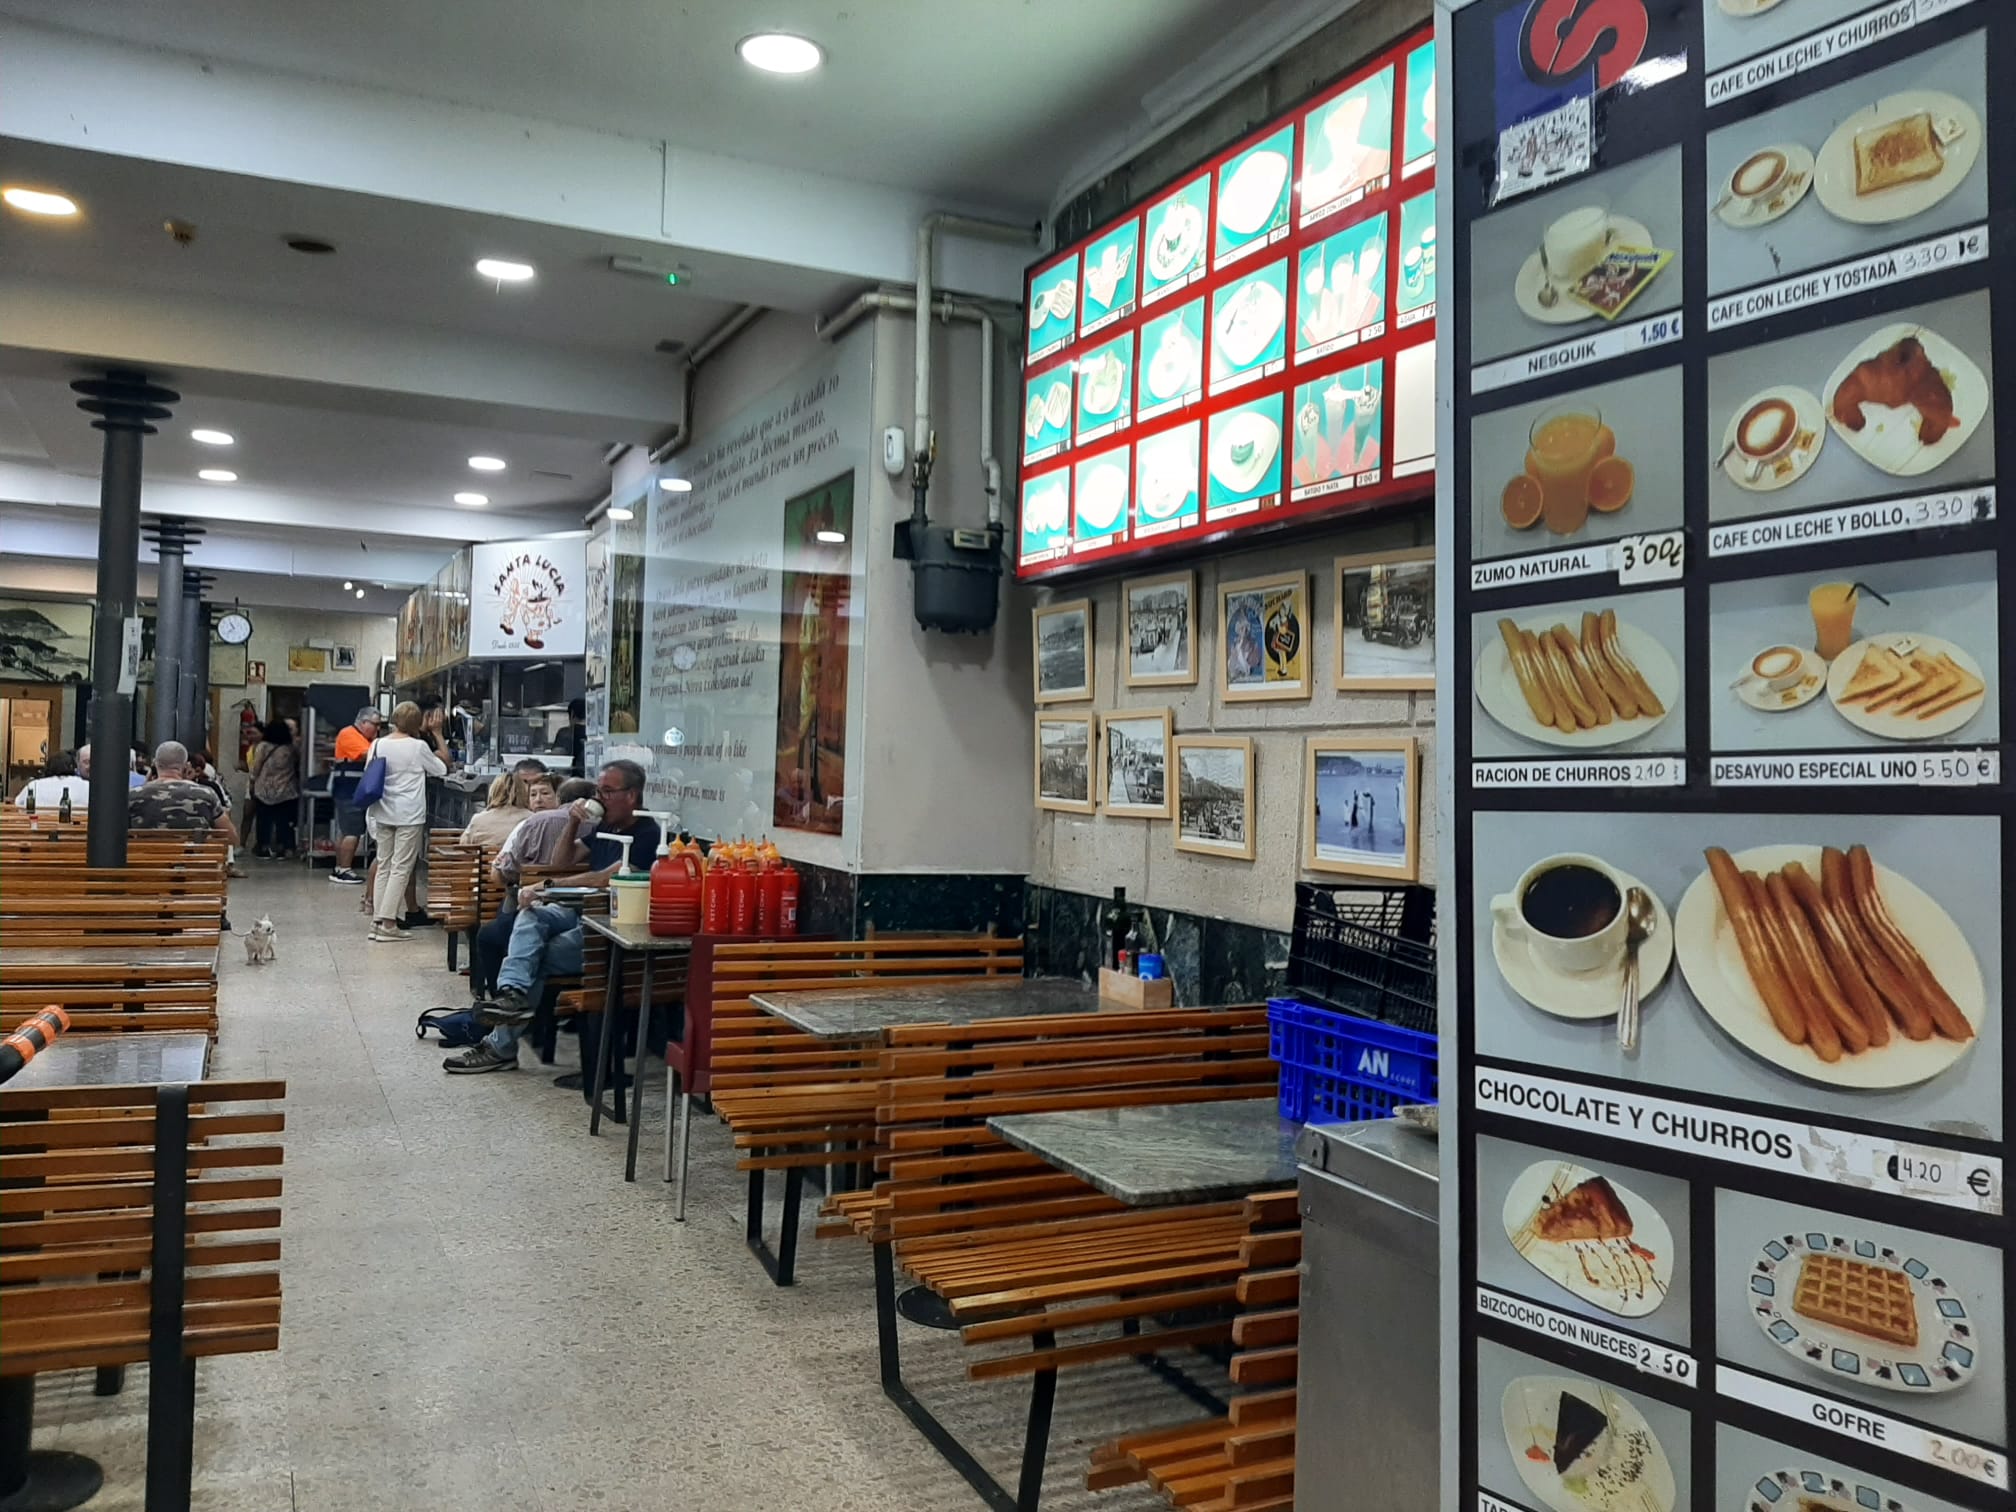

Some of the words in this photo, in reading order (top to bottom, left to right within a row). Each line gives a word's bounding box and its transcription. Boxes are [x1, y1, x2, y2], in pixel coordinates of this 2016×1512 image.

[1710, 76, 1744, 100] CAFE
[1747, 61, 1775, 86] CON
[1778, 42, 1823, 73] LECHE
[1825, 37, 1834, 54] Y
[1838, 6, 1911, 49] CHURROS
[1711, 301, 1744, 324] CAFE
[1746, 294, 1774, 315] CON
[1777, 279, 1820, 307] LECHE
[1822, 276, 1832, 294] Y
[1834, 259, 1897, 289] TOSTADA
[1528, 341, 1596, 374] NESQUIK
[1640, 321, 1667, 344] 1.50
[1671, 318, 1680, 335] €
[1713, 531, 1749, 550] CAFE
[1752, 525, 1782, 546] CON
[1785, 517, 1833, 540] LECHE
[1837, 516, 1847, 533] Y
[494, 554, 530, 596] SANTA
[535, 554, 566, 597] LUCIA
[1474, 565, 1515, 584] ZUMO
[1519, 554, 1591, 578] NATURAL
[1475, 768, 1528, 782] RACION
[1532, 768, 1551, 782] DE
[1555, 766, 1631, 782] CHURROS
[1715, 762, 1794, 780] DESAYUNO
[1799, 761, 1876, 779] ESPECIAL
[1881, 760, 1917, 778] UNO
[1923, 758, 1970, 779] 5.50
[1358, 1048, 1389, 1078] AN
[1477, 1078, 1620, 1125] CHOCOLATE
[1627, 1107, 1644, 1130] Y
[1652, 1111, 1793, 1159] CHURROS
[1902, 1156, 1943, 1184] 4.20
[1967, 1168, 1991, 1198] €
[1480, 1294, 1545, 1327] BIZCOCHO
[1549, 1318, 1577, 1339] CON
[1580, 1327, 1637, 1358] NUECES
[1639, 1348, 1690, 1378] 2.50
[1813, 1403, 1886, 1441] GOFRE
